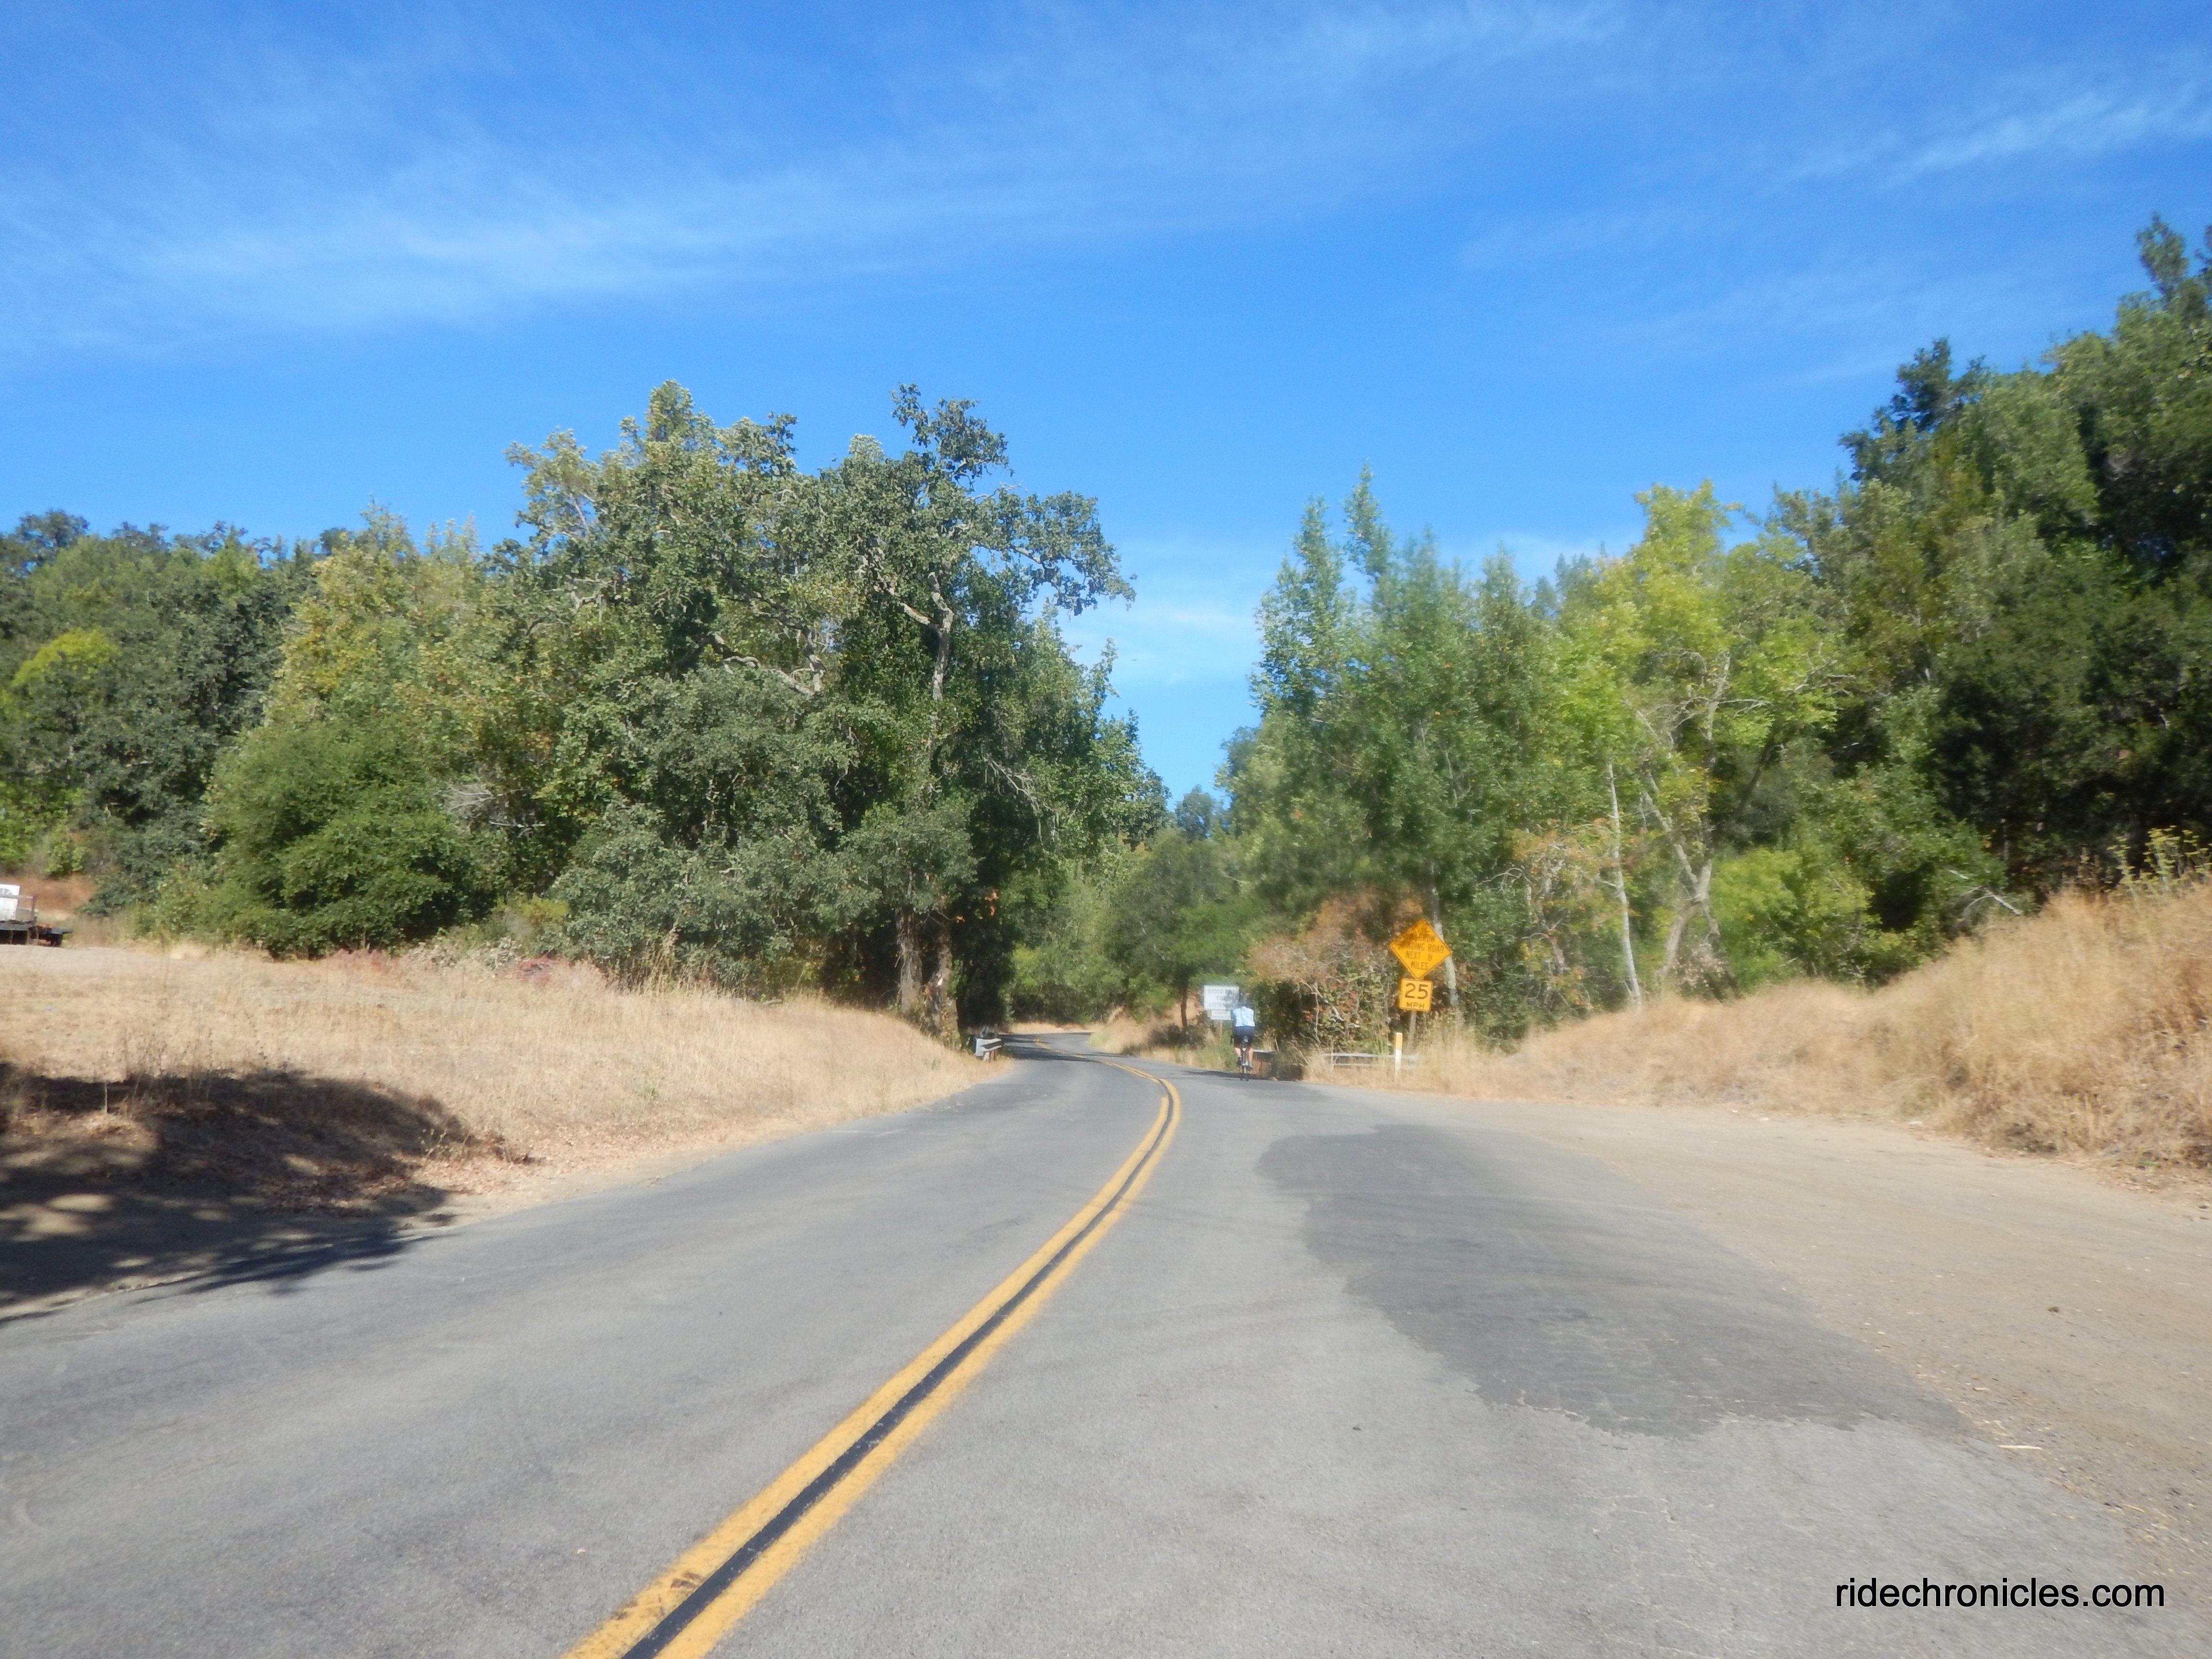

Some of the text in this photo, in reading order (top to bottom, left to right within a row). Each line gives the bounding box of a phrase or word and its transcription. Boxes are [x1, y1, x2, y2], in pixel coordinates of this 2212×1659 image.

[1428, 944, 1444, 953] ROAD
[1406, 951, 1421, 960] NEXT
[1411, 961, 1428, 970] MILES
[1405, 983, 1428, 999] 25
